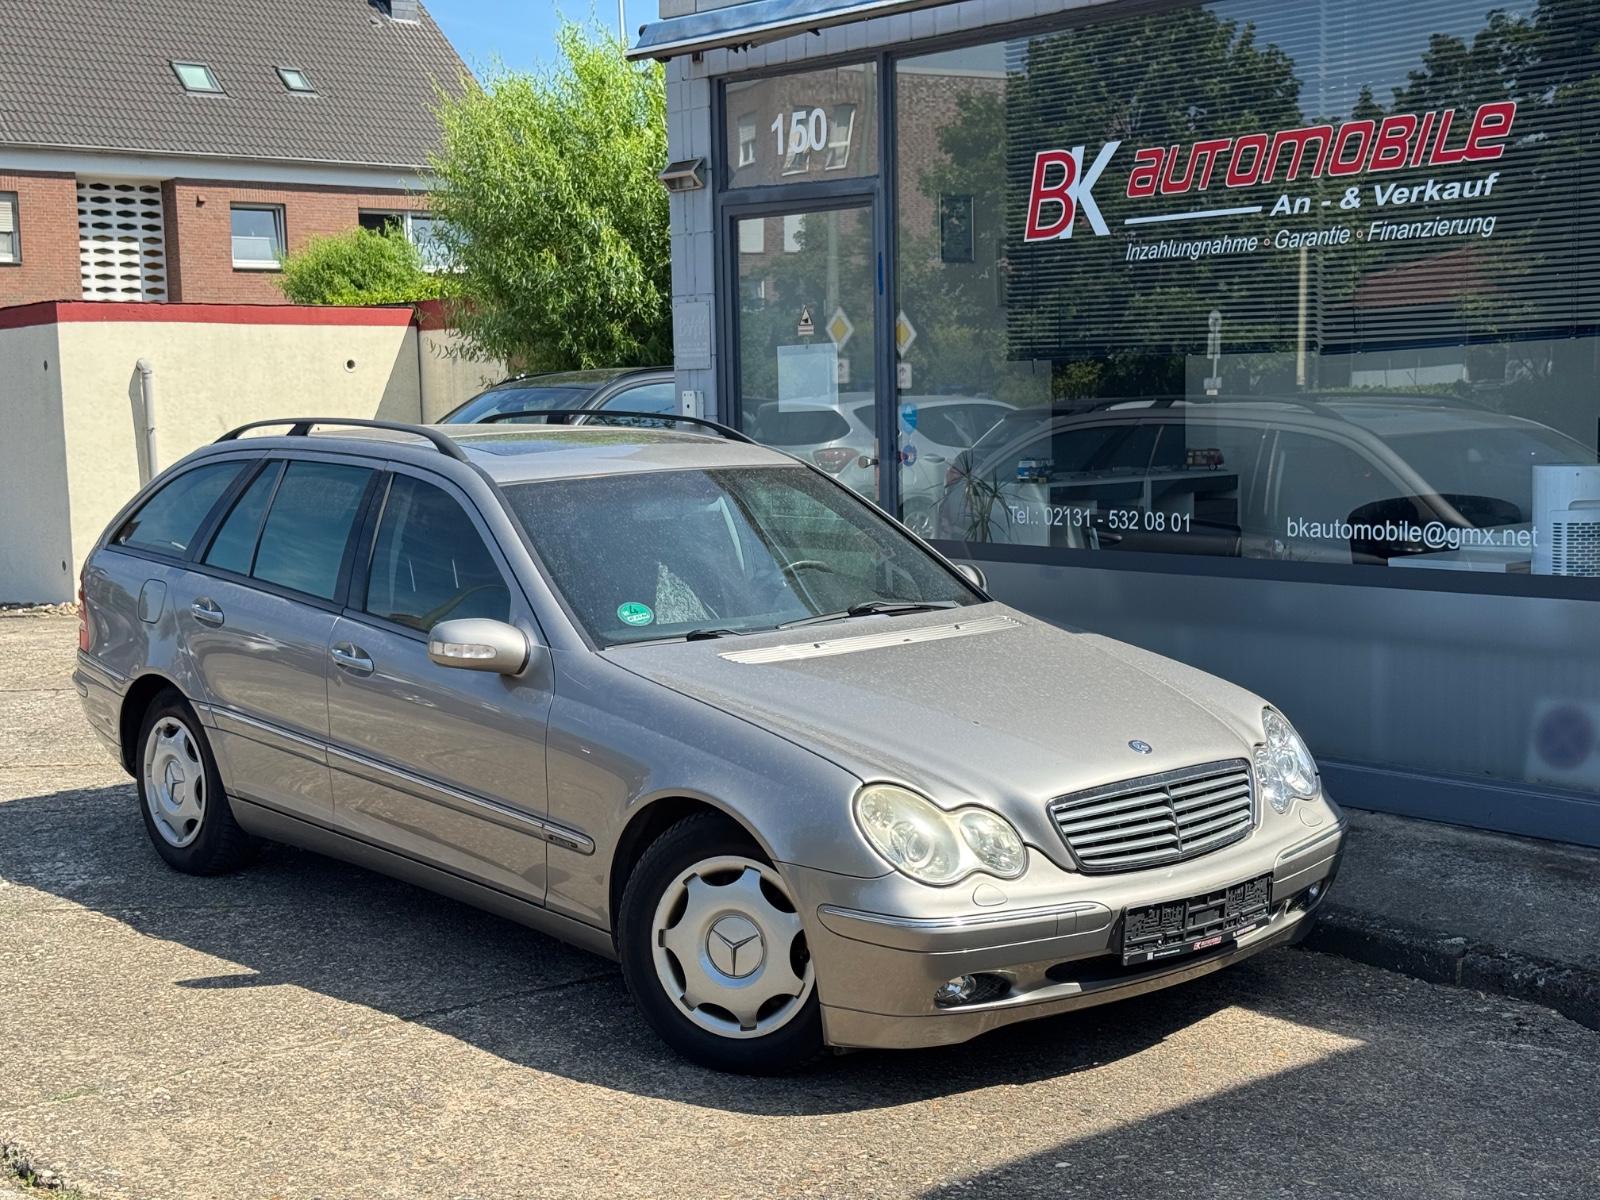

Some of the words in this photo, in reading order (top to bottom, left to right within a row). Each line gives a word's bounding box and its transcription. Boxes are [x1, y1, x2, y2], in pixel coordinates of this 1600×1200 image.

[771, 108, 828, 155] 150
[1023, 140, 1122, 242] BK
[1269, 193, 1311, 217] An
[1339, 186, 1361, 210] &
[1374, 172, 1500, 207] Verkauf
[1125, 234, 1259, 261] Inzahlungnahme
[1274, 225, 1350, 249] Garantie
[1367, 215, 1497, 242] Finanzierung
[1009, 505, 1039, 525] Tel.:
[1044, 507, 1091, 527] 02131
[1108, 510, 1139, 530] 532
[1144, 511, 1165, 531] 08
[1171, 512, 1190, 533] 01
[1287, 517, 1539, 549] bkautomobile@gmx.net
